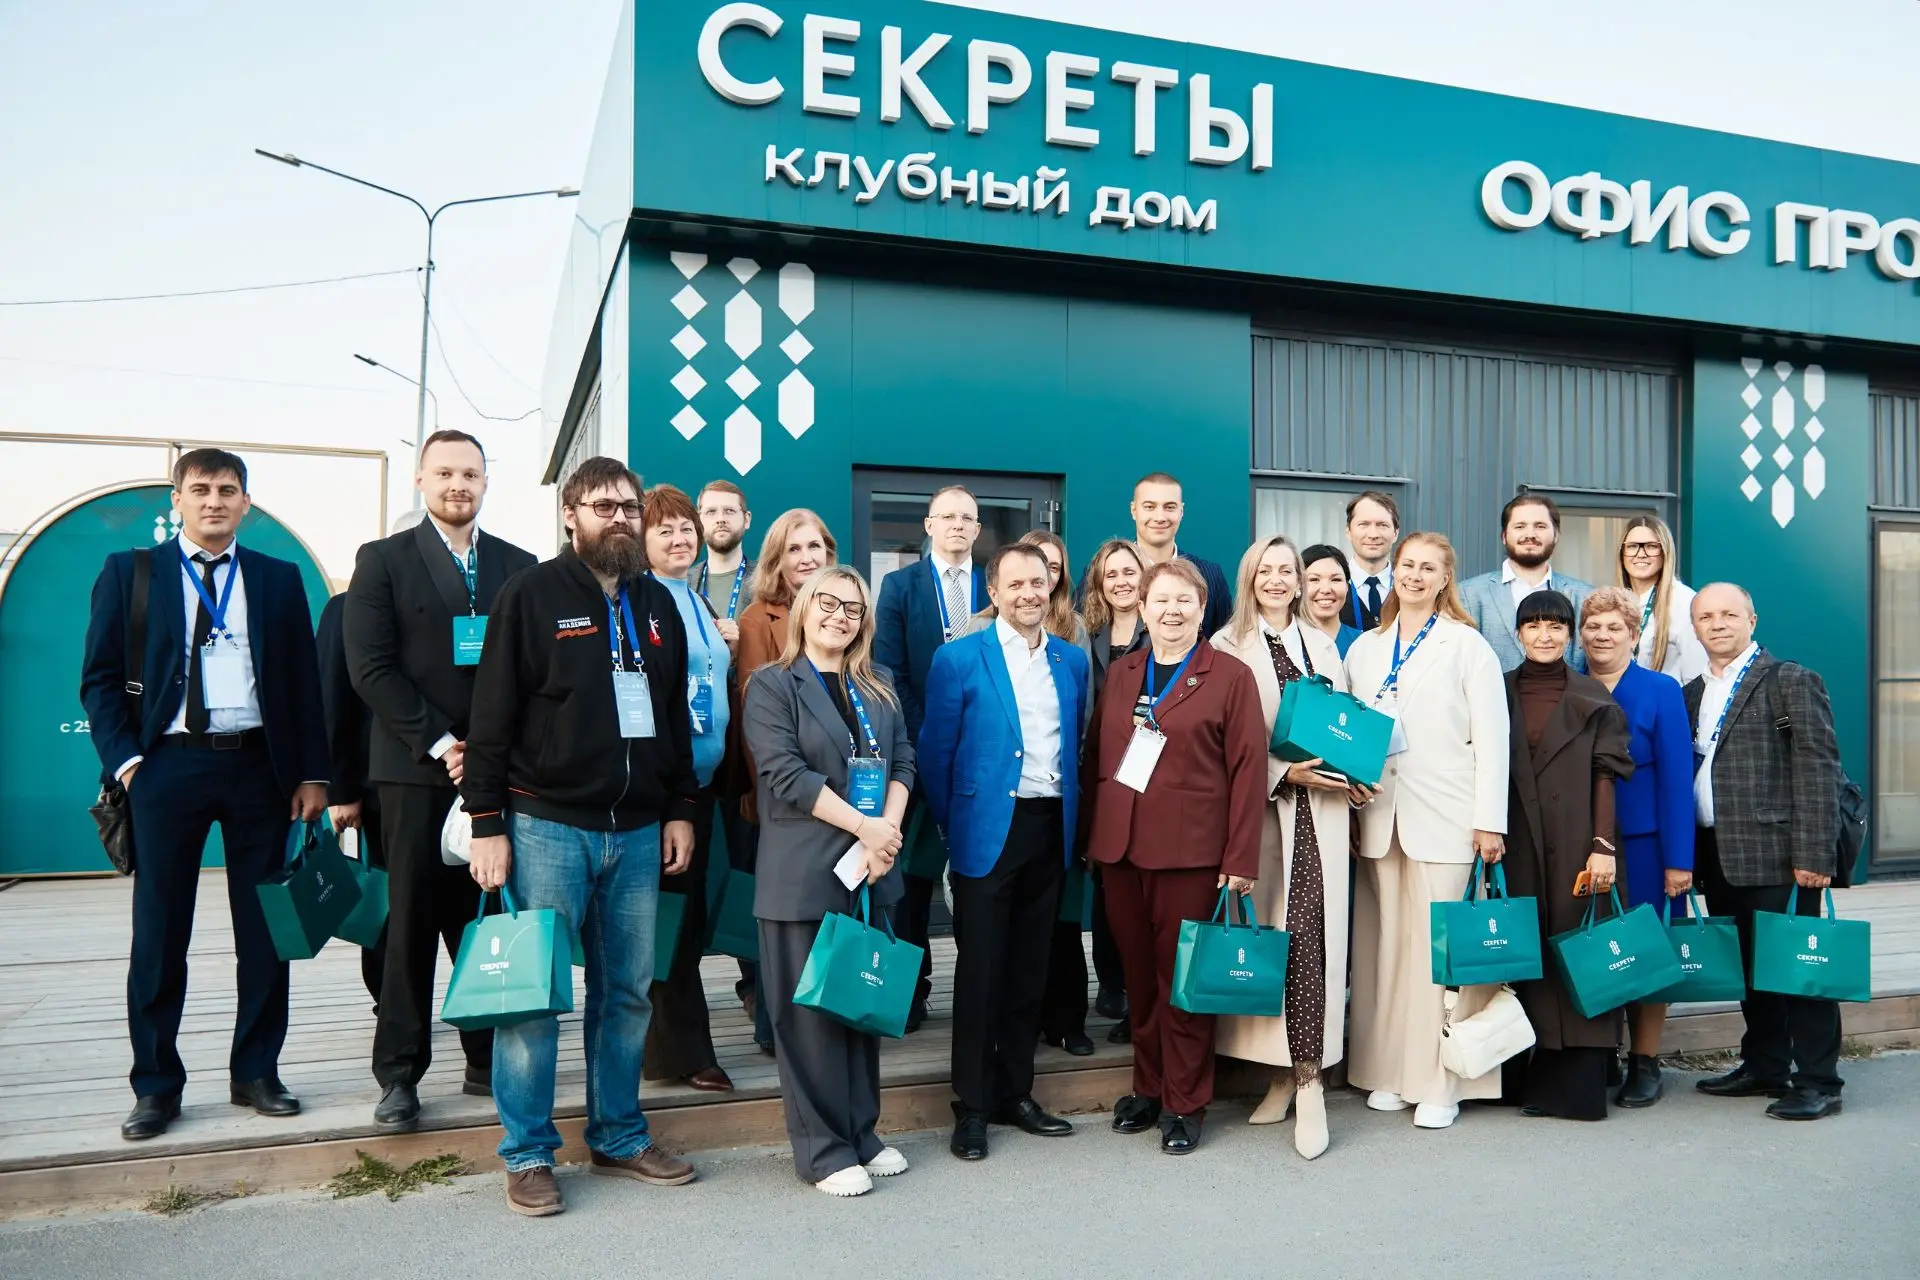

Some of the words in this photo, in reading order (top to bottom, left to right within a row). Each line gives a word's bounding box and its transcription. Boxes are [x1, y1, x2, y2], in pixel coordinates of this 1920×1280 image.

[697, 2, 1274, 171] СЕКРЕТЫ
[764, 144, 1069, 217] клубный
[1089, 185, 1218, 233] дом
[1481, 160, 1751, 257] ОФИС
[1775, 201, 1920, 280] ПРО
[1327, 724, 1353, 741] СЕКРЕТЫ
[1482, 939, 1508, 947] СЕКРЕТЫ
[1608, 955, 1636, 971] СЕКРЕТЫ
[1796, 953, 1829, 963] СЕКРЕТЫ
[860, 971, 884, 986] СЕКРЕТЫ
[1229, 969, 1254, 978] СЕКРЕТЫ
